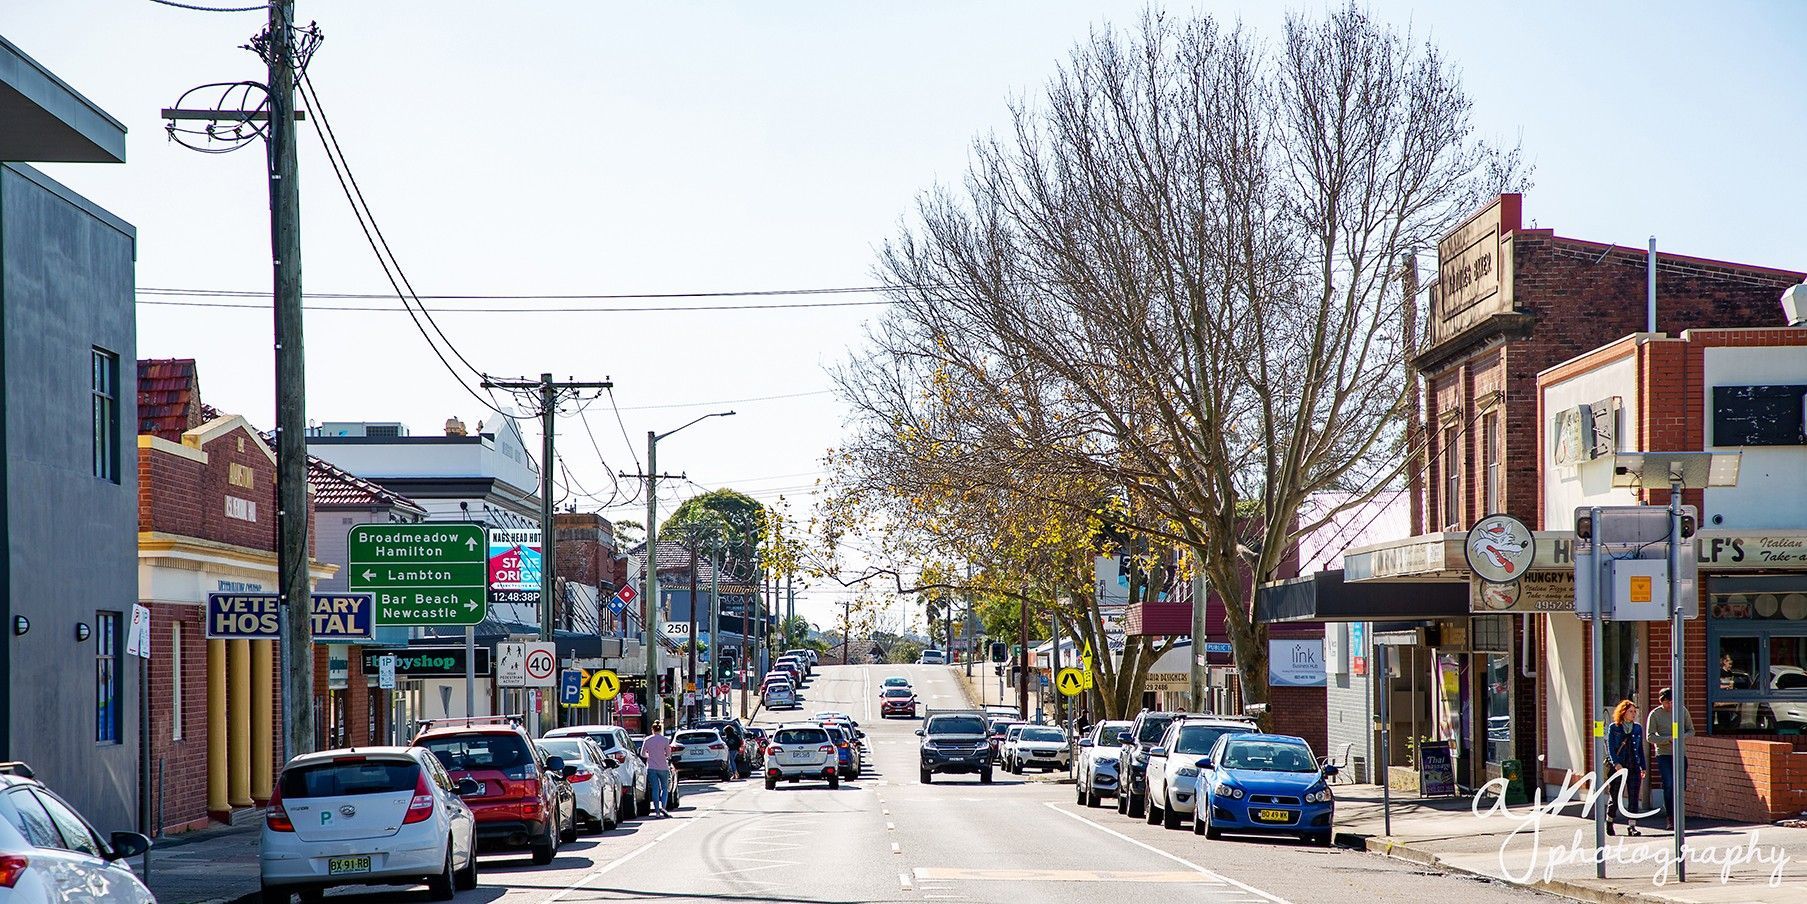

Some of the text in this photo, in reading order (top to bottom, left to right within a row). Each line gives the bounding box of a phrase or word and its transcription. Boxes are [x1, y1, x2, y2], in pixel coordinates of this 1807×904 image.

[359, 533, 459, 543] Broadmeadow
[493, 533, 541, 542] NAGS HEAD HOT
[1760, 537, 1803, 548] Italian
[376, 547, 443, 556] Hamilton
[1697, 537, 1744, 562] LF'S
[1760, 551, 1807, 561] Take-a
[503, 558, 540, 568] STATE
[388, 570, 452, 580] Lambton
[1524, 572, 1563, 583] HUNGRY
[382, 594, 458, 604] Bar Beach
[493, 593, 540, 601] 12:48:38P
[218, 597, 363, 613] VETEARY
[1536, 600, 1563, 610] 4952
[383, 608, 457, 618] Newcastle
[217, 613, 364, 634] HOSTAL
[667, 624, 689, 634] 250
[1292, 644, 1315, 663] link
[383, 658, 391, 666] 1P
[530, 656, 552, 672] 40
[566, 685, 578, 700] P
[320, 811, 332, 826] P
